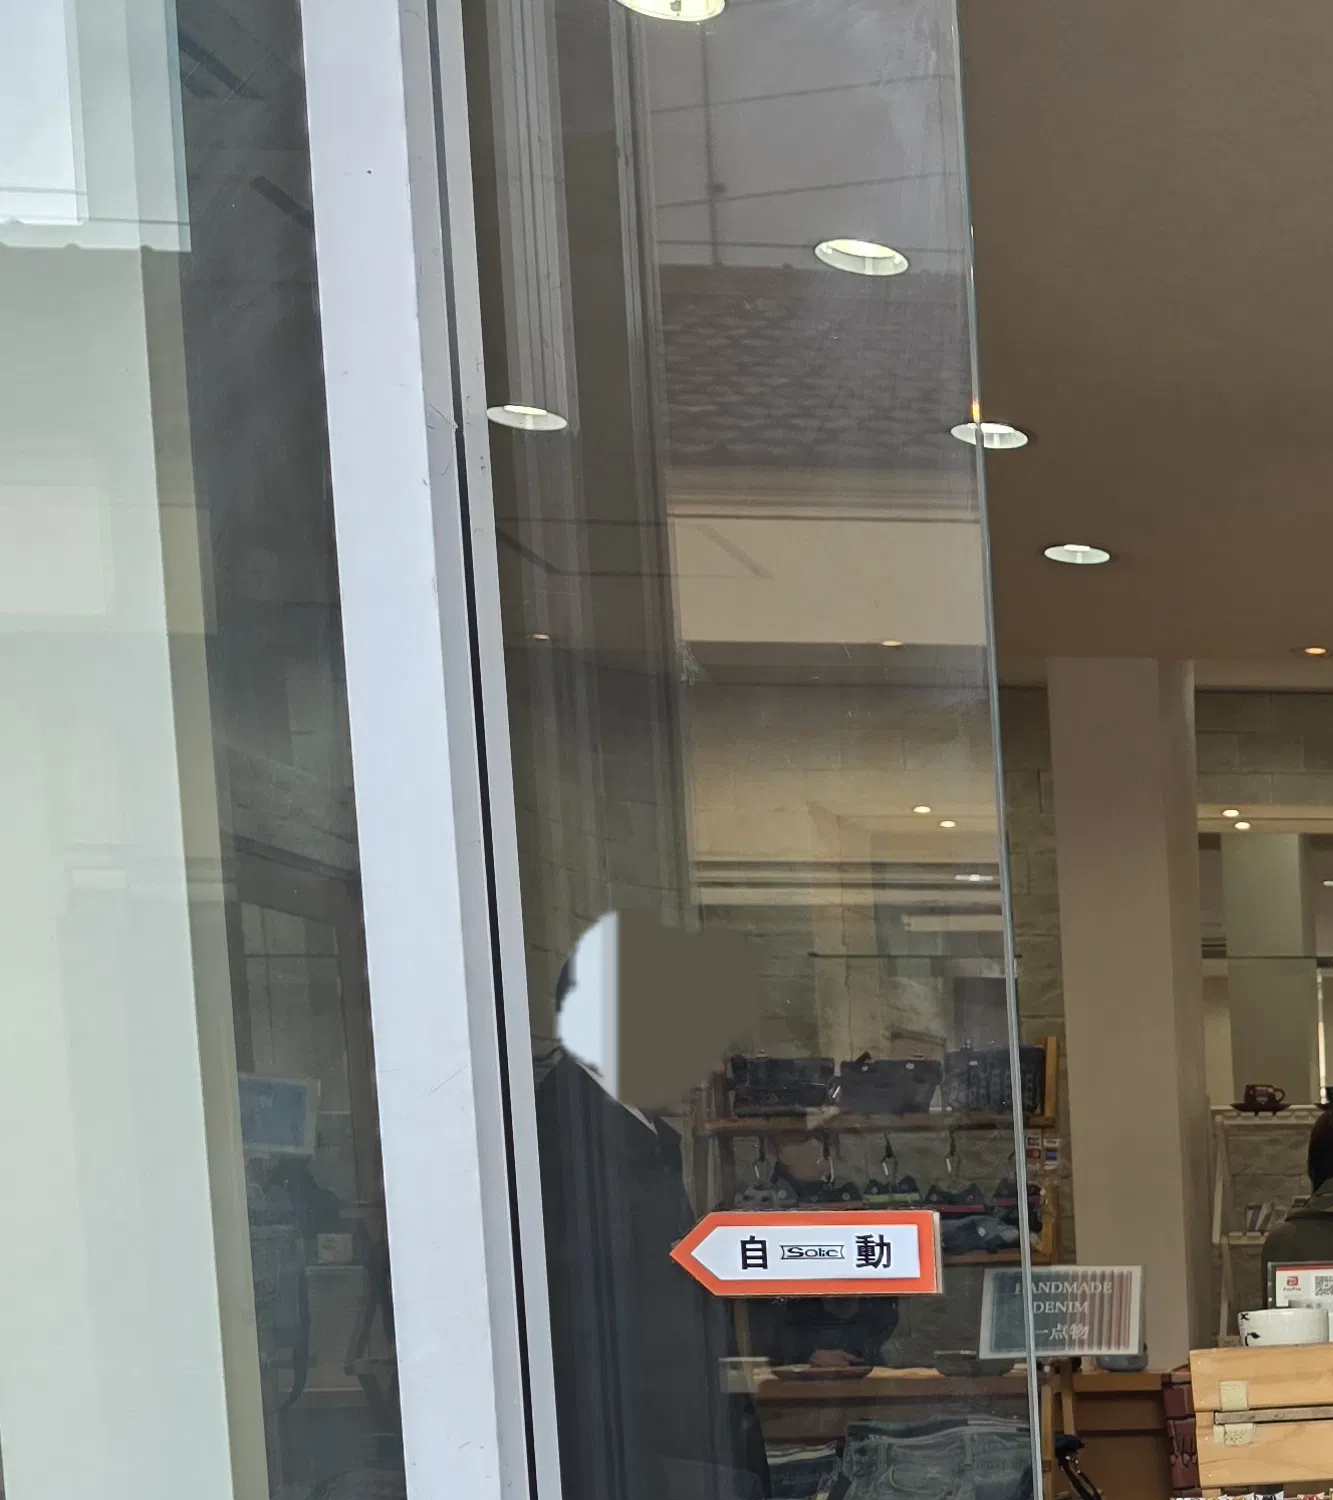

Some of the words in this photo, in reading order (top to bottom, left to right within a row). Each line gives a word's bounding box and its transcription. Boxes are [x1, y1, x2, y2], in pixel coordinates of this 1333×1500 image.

[739, 1235, 768, 1269] 自
[855, 1233, 892, 1269] 動
[1033, 1301, 1089, 1314] DENIM
